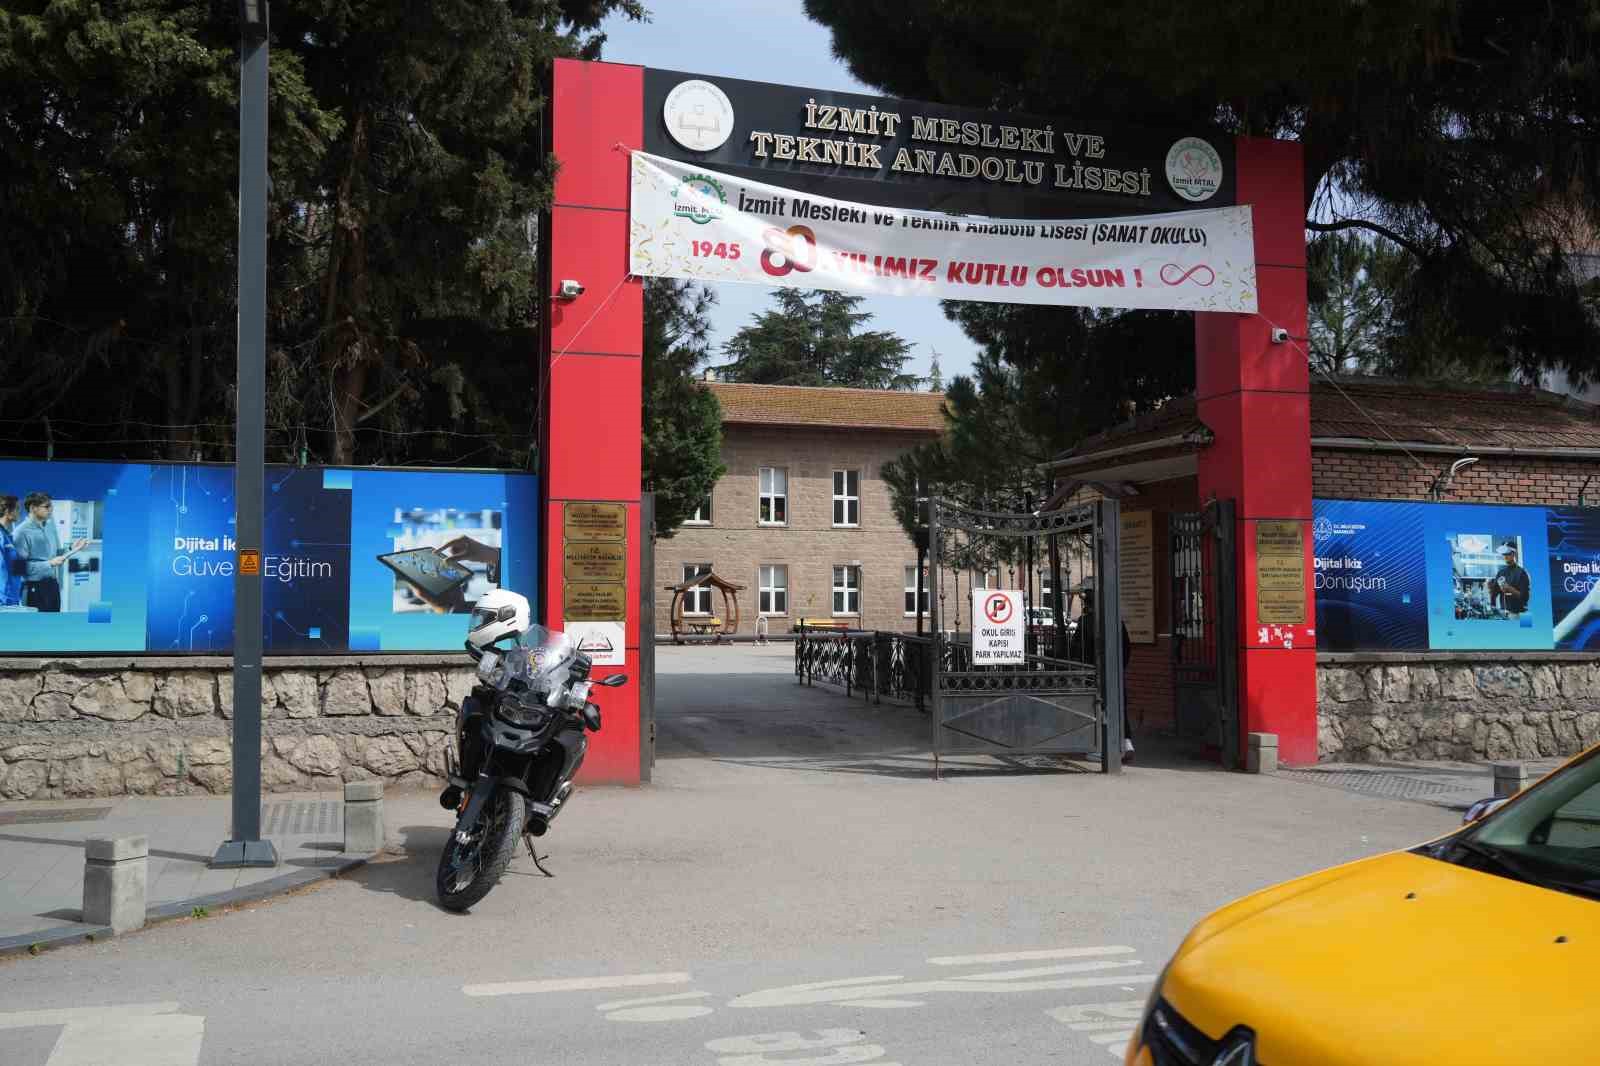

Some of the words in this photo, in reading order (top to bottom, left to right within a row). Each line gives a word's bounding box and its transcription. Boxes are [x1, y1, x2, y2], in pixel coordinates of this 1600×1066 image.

[805, 98, 900, 137] İZMİT
[912, 116, 1054, 154] MESLEKİ
[1064, 132, 1105, 159] VE
[750, 131, 882, 168] TEKNİK
[892, 148, 1044, 184] ANADOLU
[1054, 161, 1151, 195] LİSESİ
[738, 188, 786, 216] İzmit
[1092, 223, 1149, 245] (SANAT
[1150, 227, 1207, 247] OKULU)
[692, 240, 741, 260] 1945
[947, 261, 1028, 287] KUTLU
[1036, 264, 1126, 288] OLSUN
[1134, 268, 1143, 288] !
[174, 535, 219, 553] Dijital
[223, 534, 236, 550] İk
[172, 555, 233, 576] Güve
[264, 556, 332, 582] Eğitim
[1313, 556, 1343, 571] Dijital
[1344, 554, 1363, 569] İkiz
[1563, 562, 1590, 575] Dijital
[1591, 560, 1600, 573] İk
[981, 628, 999, 637] OKUL
[988, 639, 1009, 648] KAPISI
[975, 650, 991, 659] PARK
[993, 650, 1022, 659] YAPILMAZ
